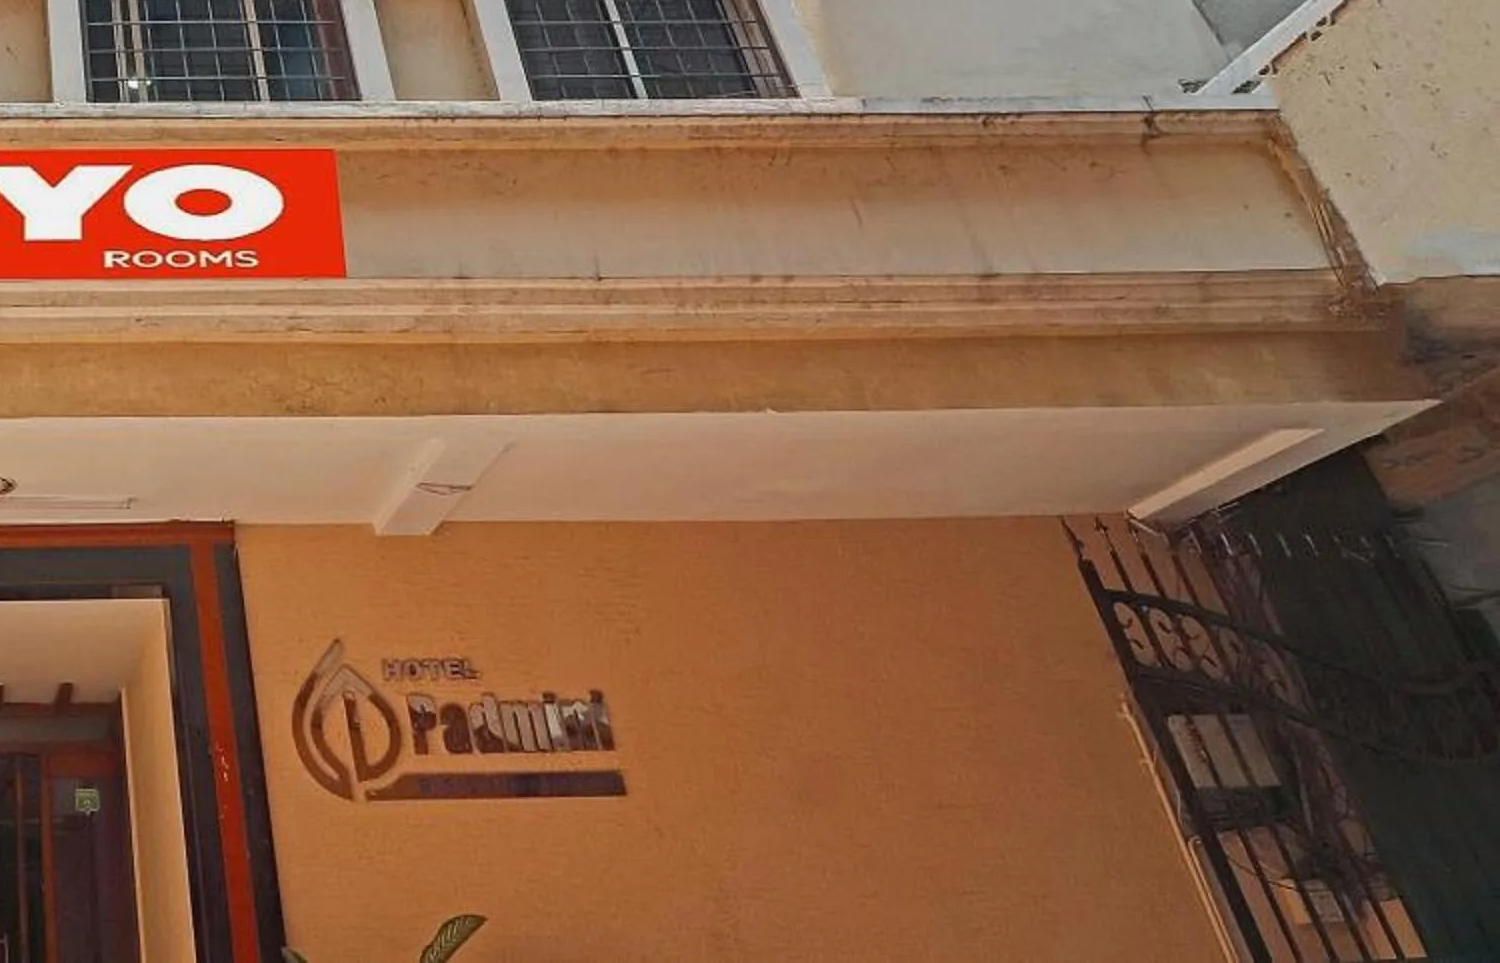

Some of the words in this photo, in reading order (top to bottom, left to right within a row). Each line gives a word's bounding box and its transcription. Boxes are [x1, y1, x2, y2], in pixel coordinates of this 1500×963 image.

[103, 250, 260, 268] ROOMS
[381, 658, 482, 680] HOTEL
[406, 689, 615, 755] Padmini
